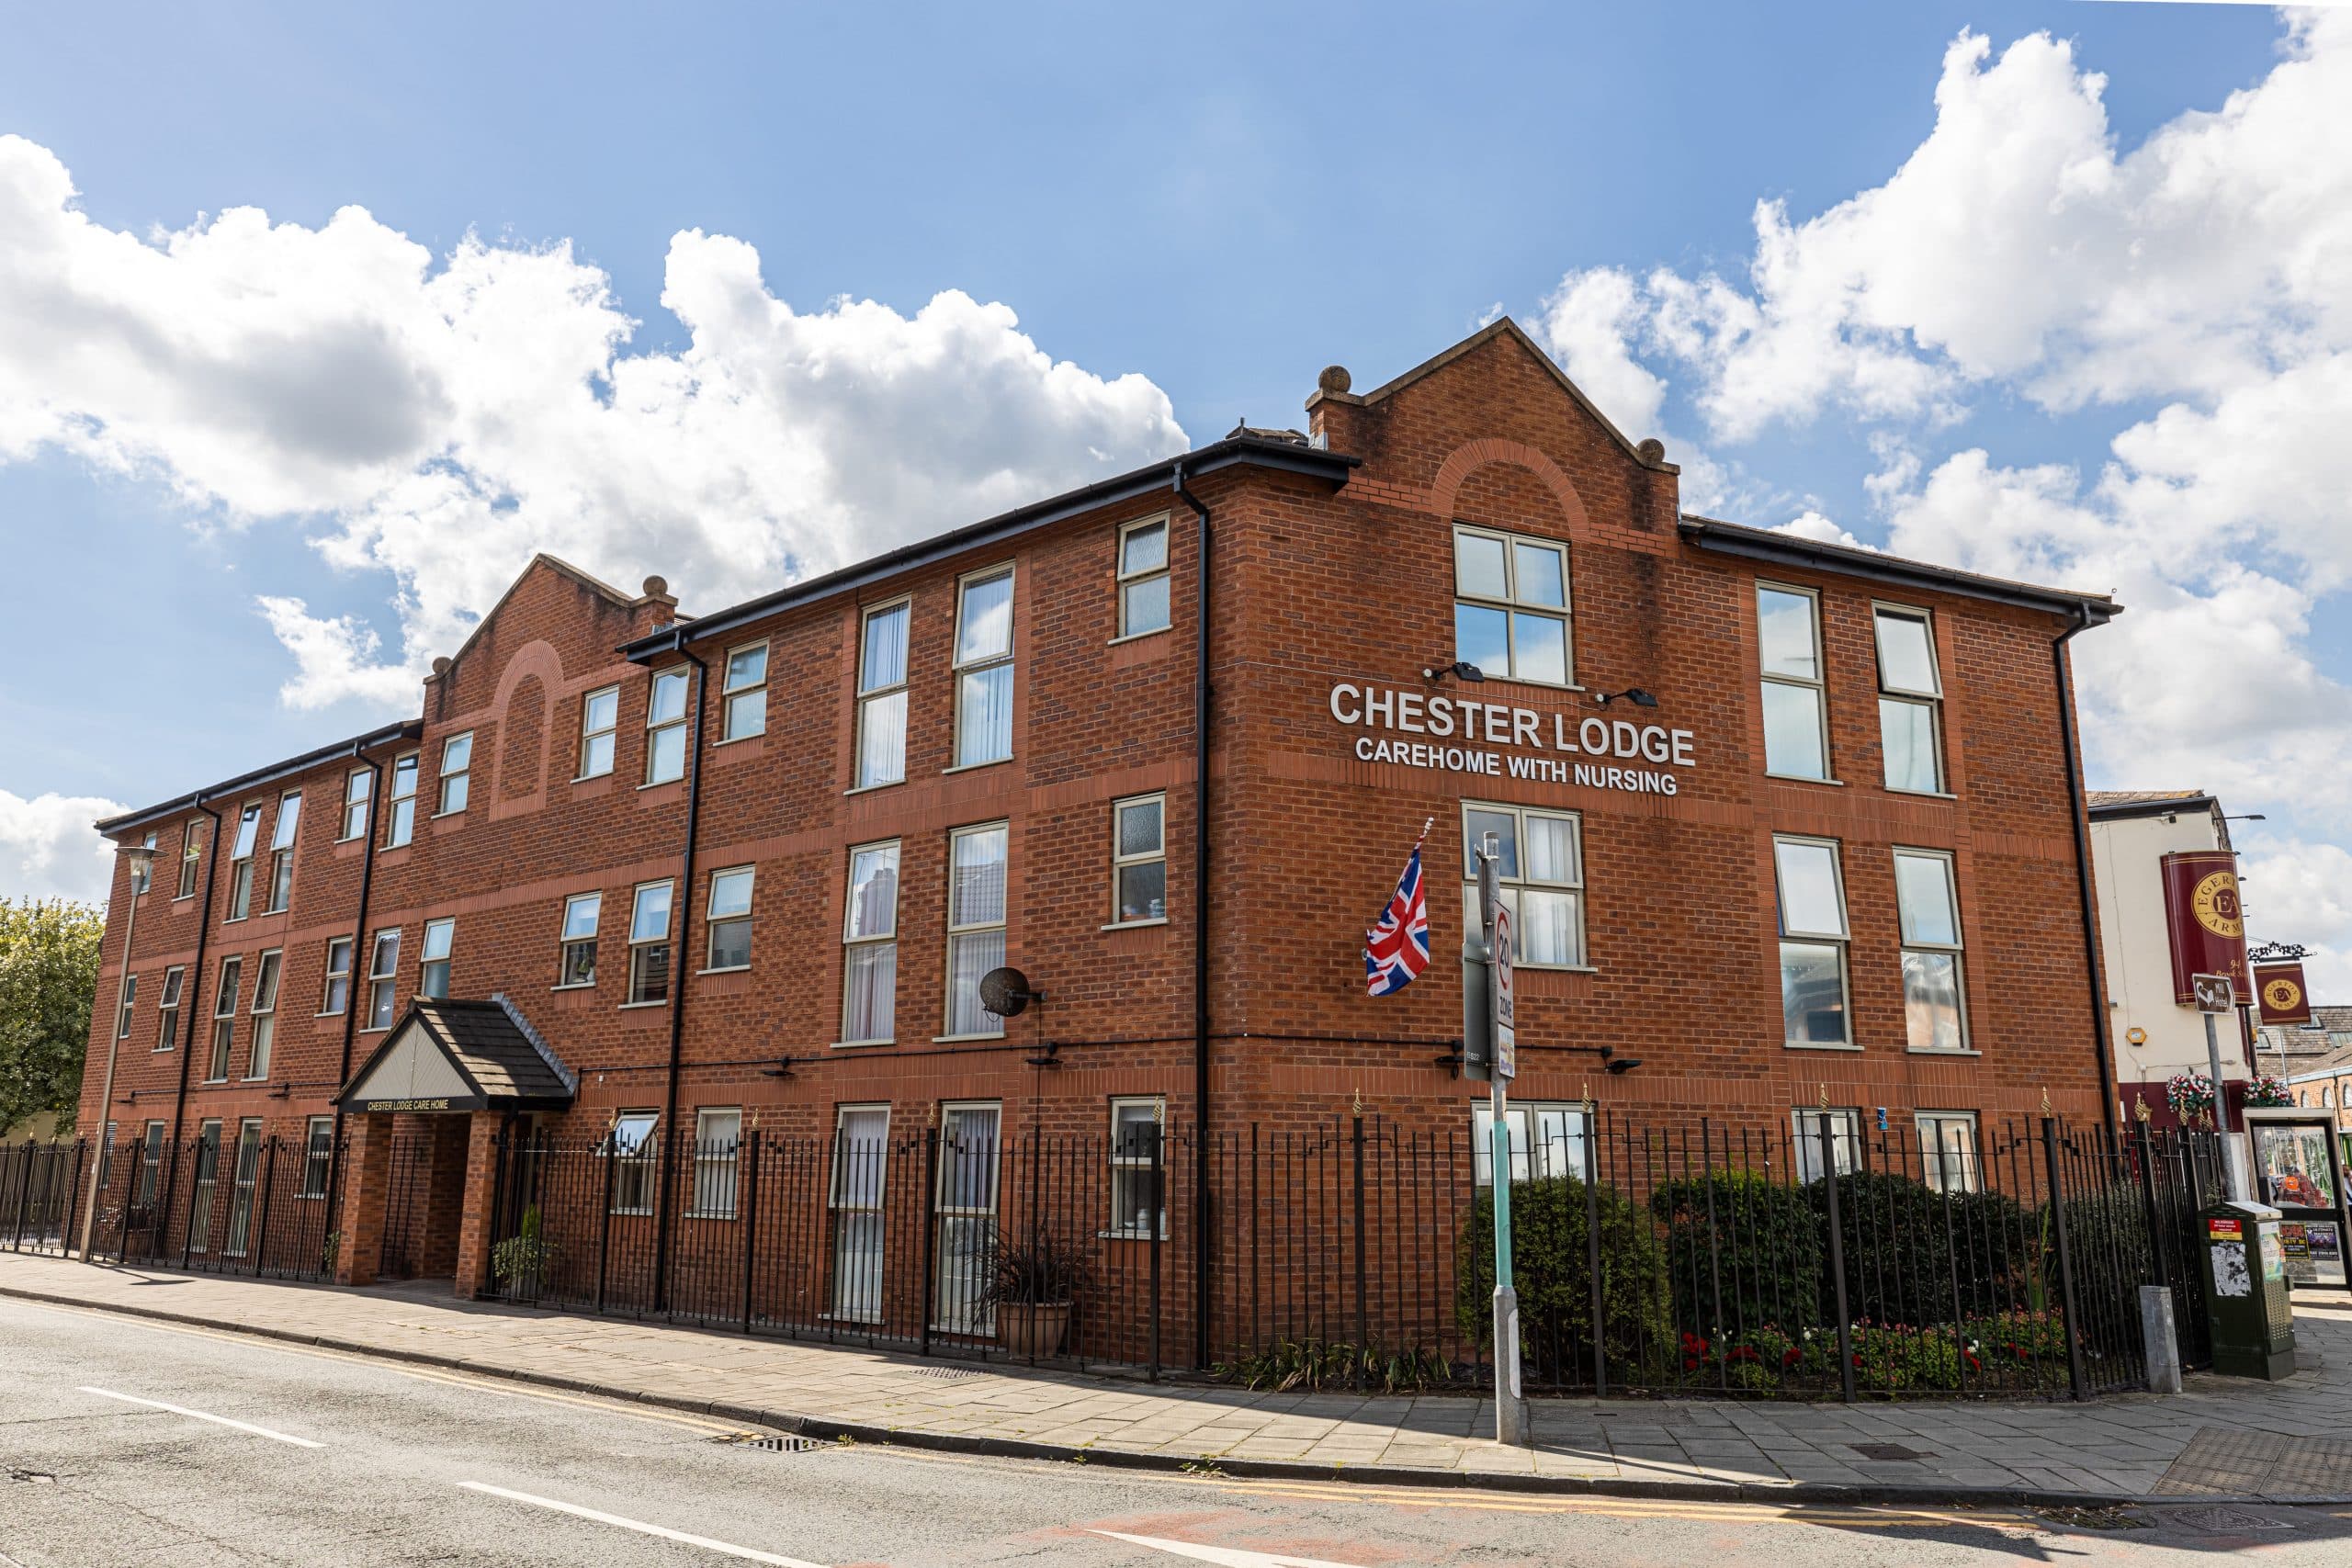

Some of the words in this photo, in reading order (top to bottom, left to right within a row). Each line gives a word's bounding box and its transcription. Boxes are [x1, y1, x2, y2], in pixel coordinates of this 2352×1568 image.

[1329, 683, 1543, 749] CHESTER
[1555, 714, 1696, 767] LODGE
[1355, 737, 1501, 777] CAREHOME
[1507, 755, 1567, 784] WITH
[1575, 763, 1678, 796] NURSING
[2198, 875, 2236, 906] EGERT
[2208, 918, 2243, 933] ARM
[1498, 933, 1510, 968] 20
[2266, 981, 2298, 997] EGERTON
[2273, 990, 2290, 999] EA
[1499, 995, 1512, 1020] ZONE
[2271, 999, 2296, 1009] ARMS
[368, 1101, 392, 1111] CHESTER
[393, 1100, 413, 1111] LODGE
[413, 1100, 430, 1110] CARE
[430, 1099, 449, 1110] HOME
